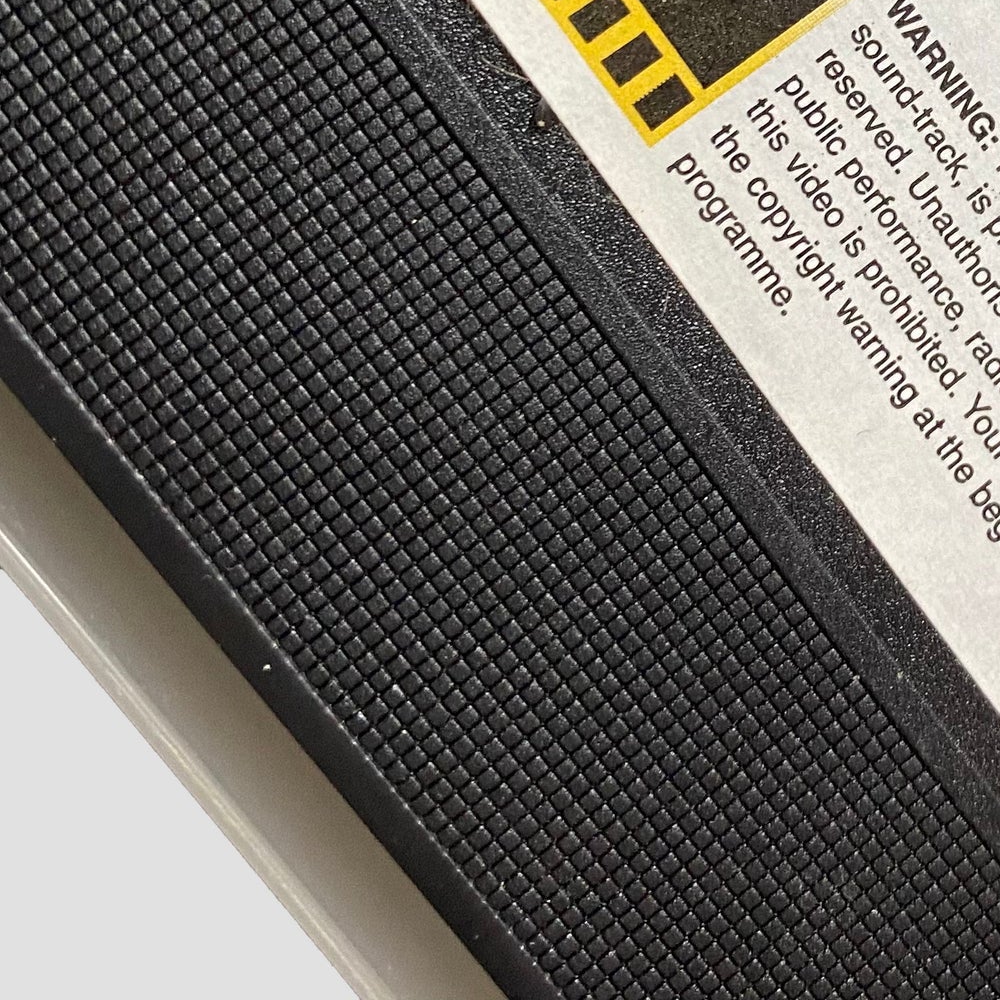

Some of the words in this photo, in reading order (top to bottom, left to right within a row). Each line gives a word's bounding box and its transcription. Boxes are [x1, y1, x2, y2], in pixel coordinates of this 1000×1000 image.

[775, 74, 846, 156] public
[834, 157, 964, 332] performance,
[815, 49, 913, 174] reserved.
[851, 24, 968, 188] sound-track,
[966, 182, 992, 214] is
[666, 152, 792, 316] programme.
[710, 123, 750, 173] the
[747, 177, 845, 301] copyright
[837, 298, 919, 409] warning
[913, 408, 945, 439] at
[936, 435, 974, 483] the
[746, 98, 789, 151] this
[787, 152, 844, 228] video
[839, 226, 865, 257] is
[854, 259, 967, 397] prohibited.
